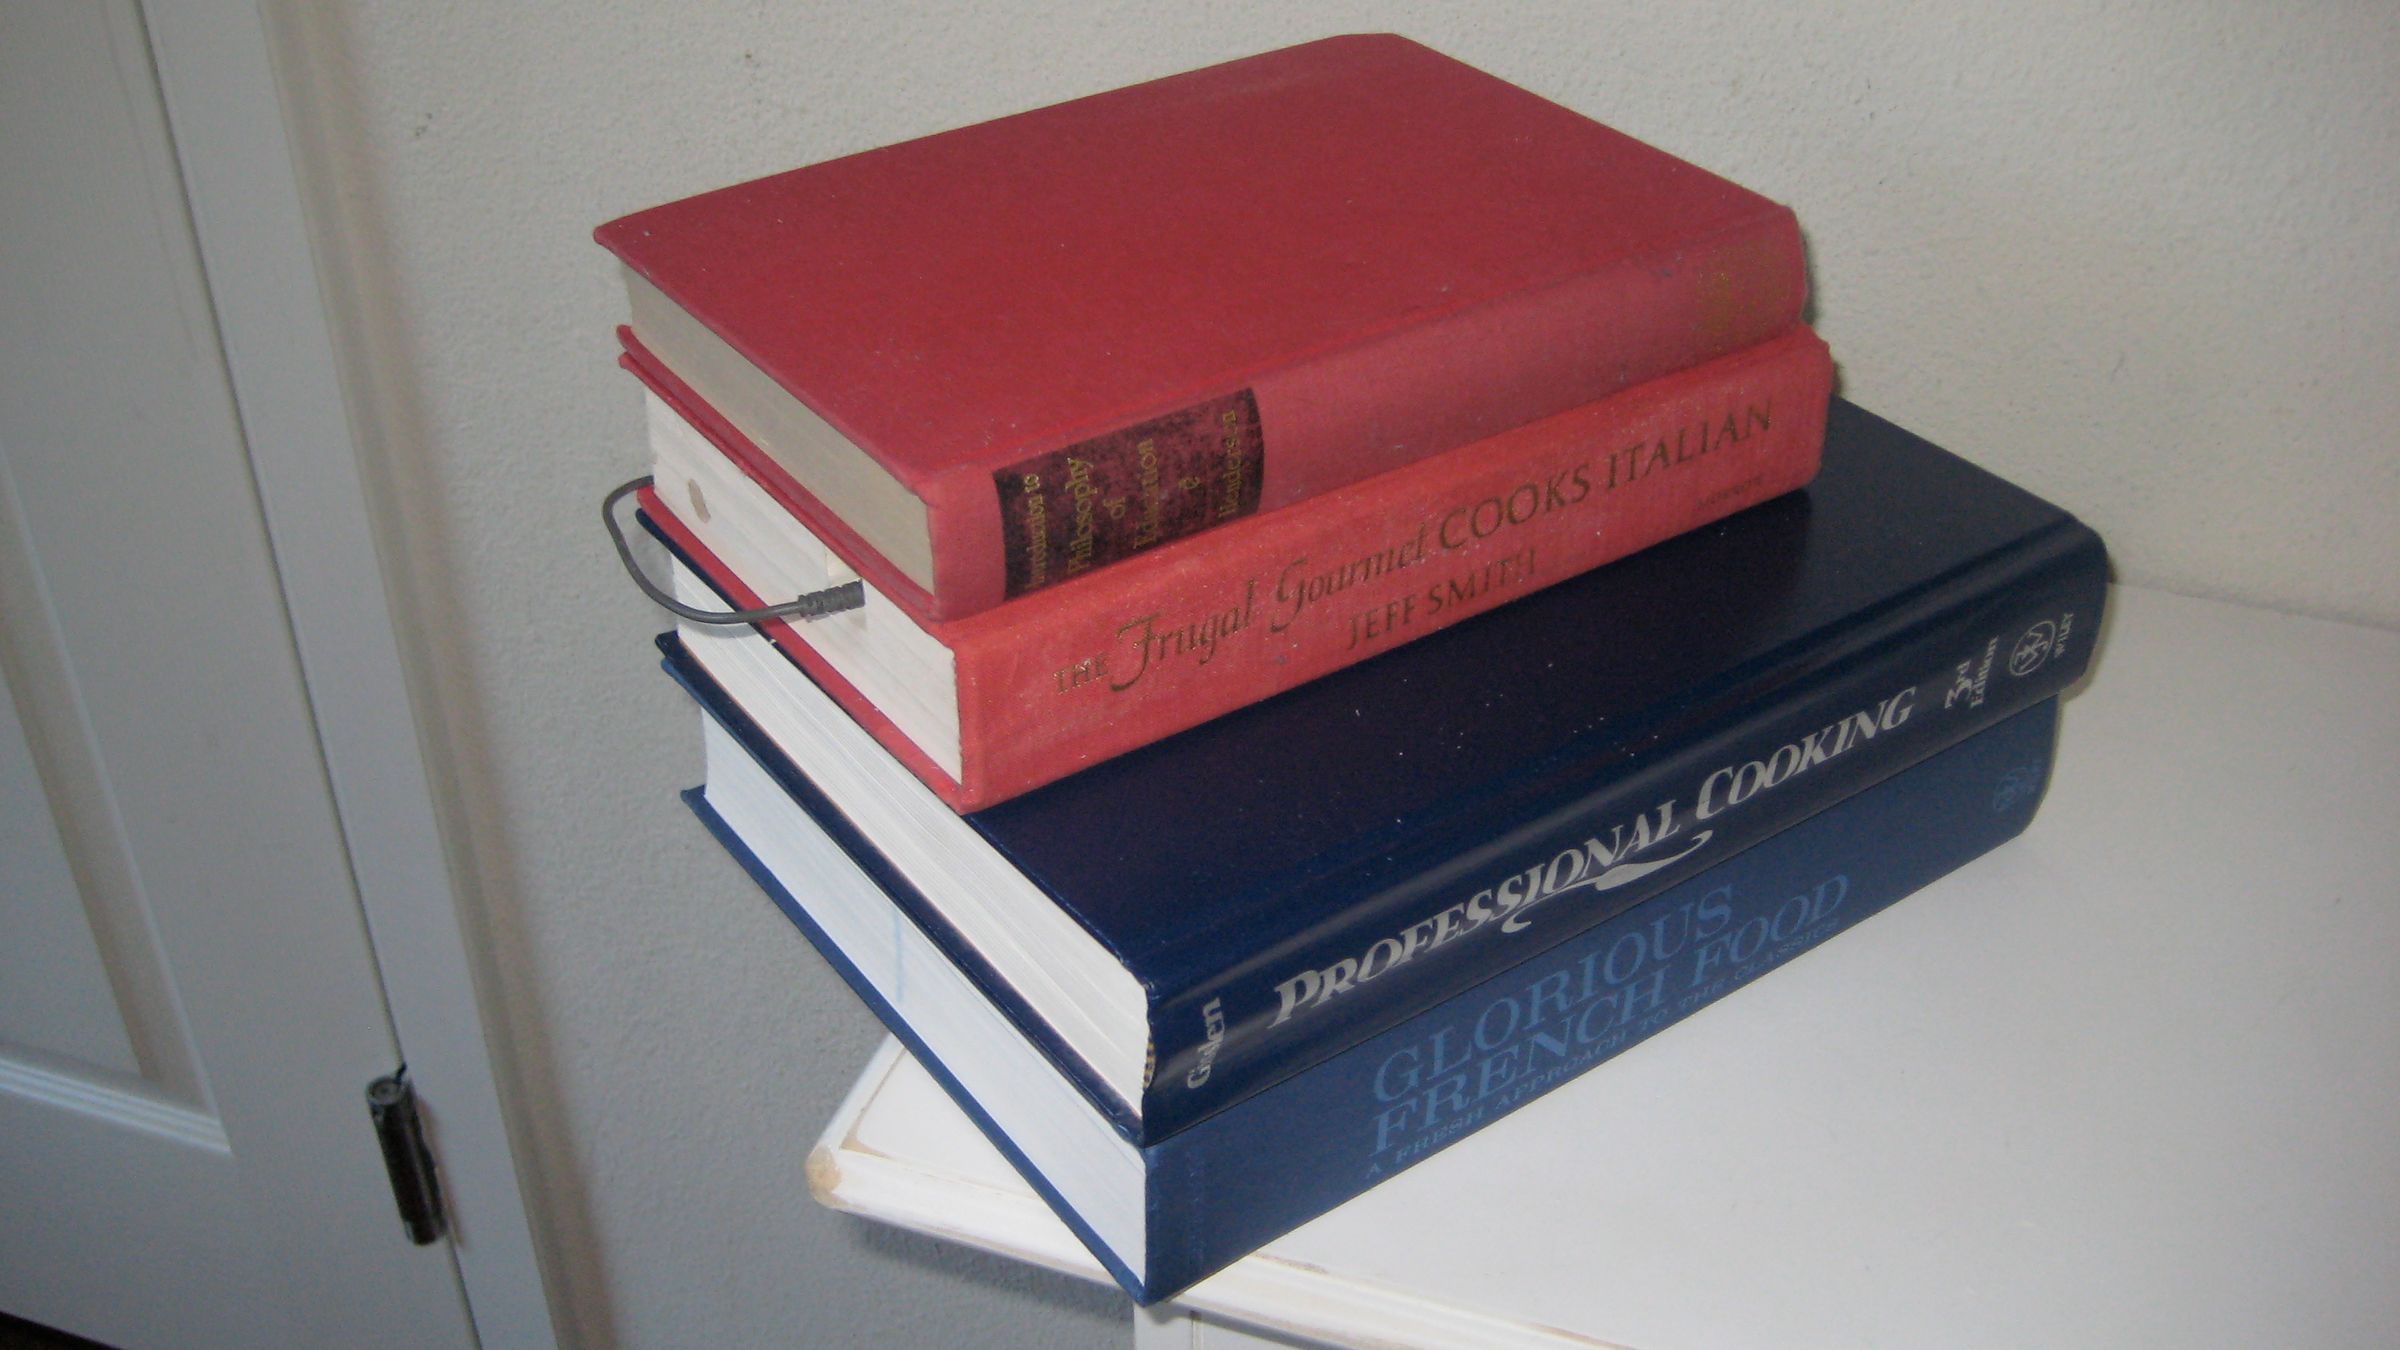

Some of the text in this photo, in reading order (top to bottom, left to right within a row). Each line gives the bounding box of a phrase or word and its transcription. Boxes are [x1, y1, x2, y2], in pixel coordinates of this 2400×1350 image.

[1023, 472, 1041, 494] to
[1064, 456, 1098, 574] Philosophy
[1102, 495, 1127, 521] of
[1051, 398, 1775, 695] THE Frugal Gourmet COOKS ITALIAN
[1348, 546, 1539, 652] JEFF SMITH
[1943, 658, 1973, 710] 3rd
[1969, 634, 2000, 710] Edition
[1266, 686, 1917, 1031] PROFESSIONAL COOKING
[1367, 873, 1849, 1157] FRENCH FOOD
[1372, 883, 1734, 1102] GLORIOUS
[1365, 1162, 1382, 1180] A
[1395, 1105, 1484, 1164] FRESH
